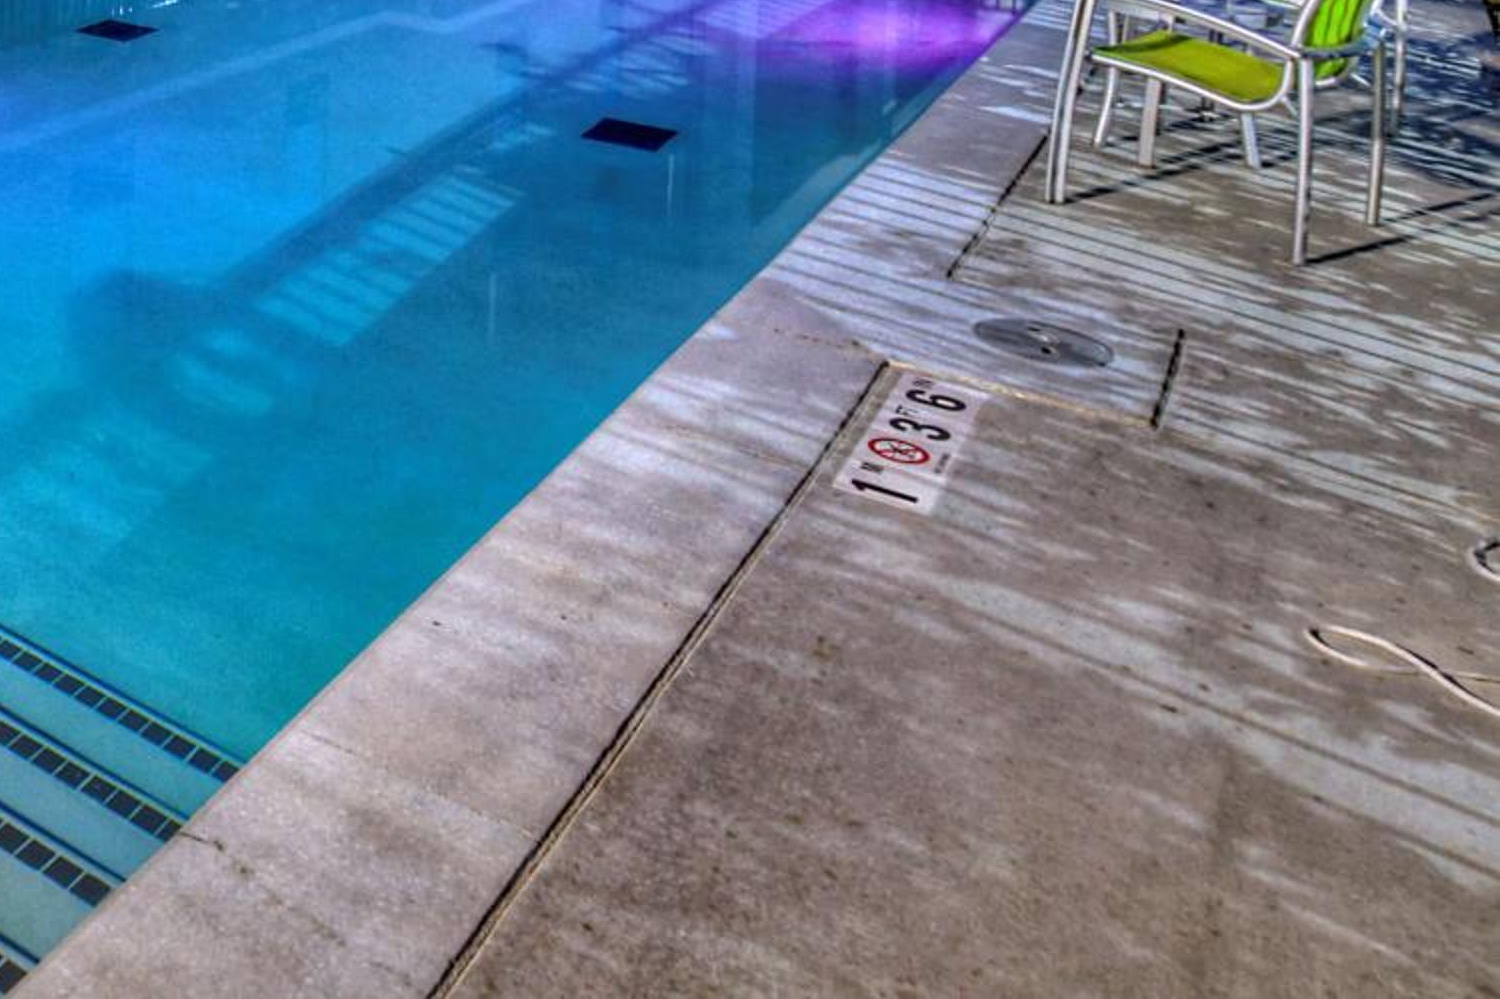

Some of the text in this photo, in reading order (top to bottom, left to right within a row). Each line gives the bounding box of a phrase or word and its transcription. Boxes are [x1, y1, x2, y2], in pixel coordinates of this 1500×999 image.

[905, 389, 966, 411] 6
[889, 417, 951, 441] 3
[852, 479, 918, 503] 1
